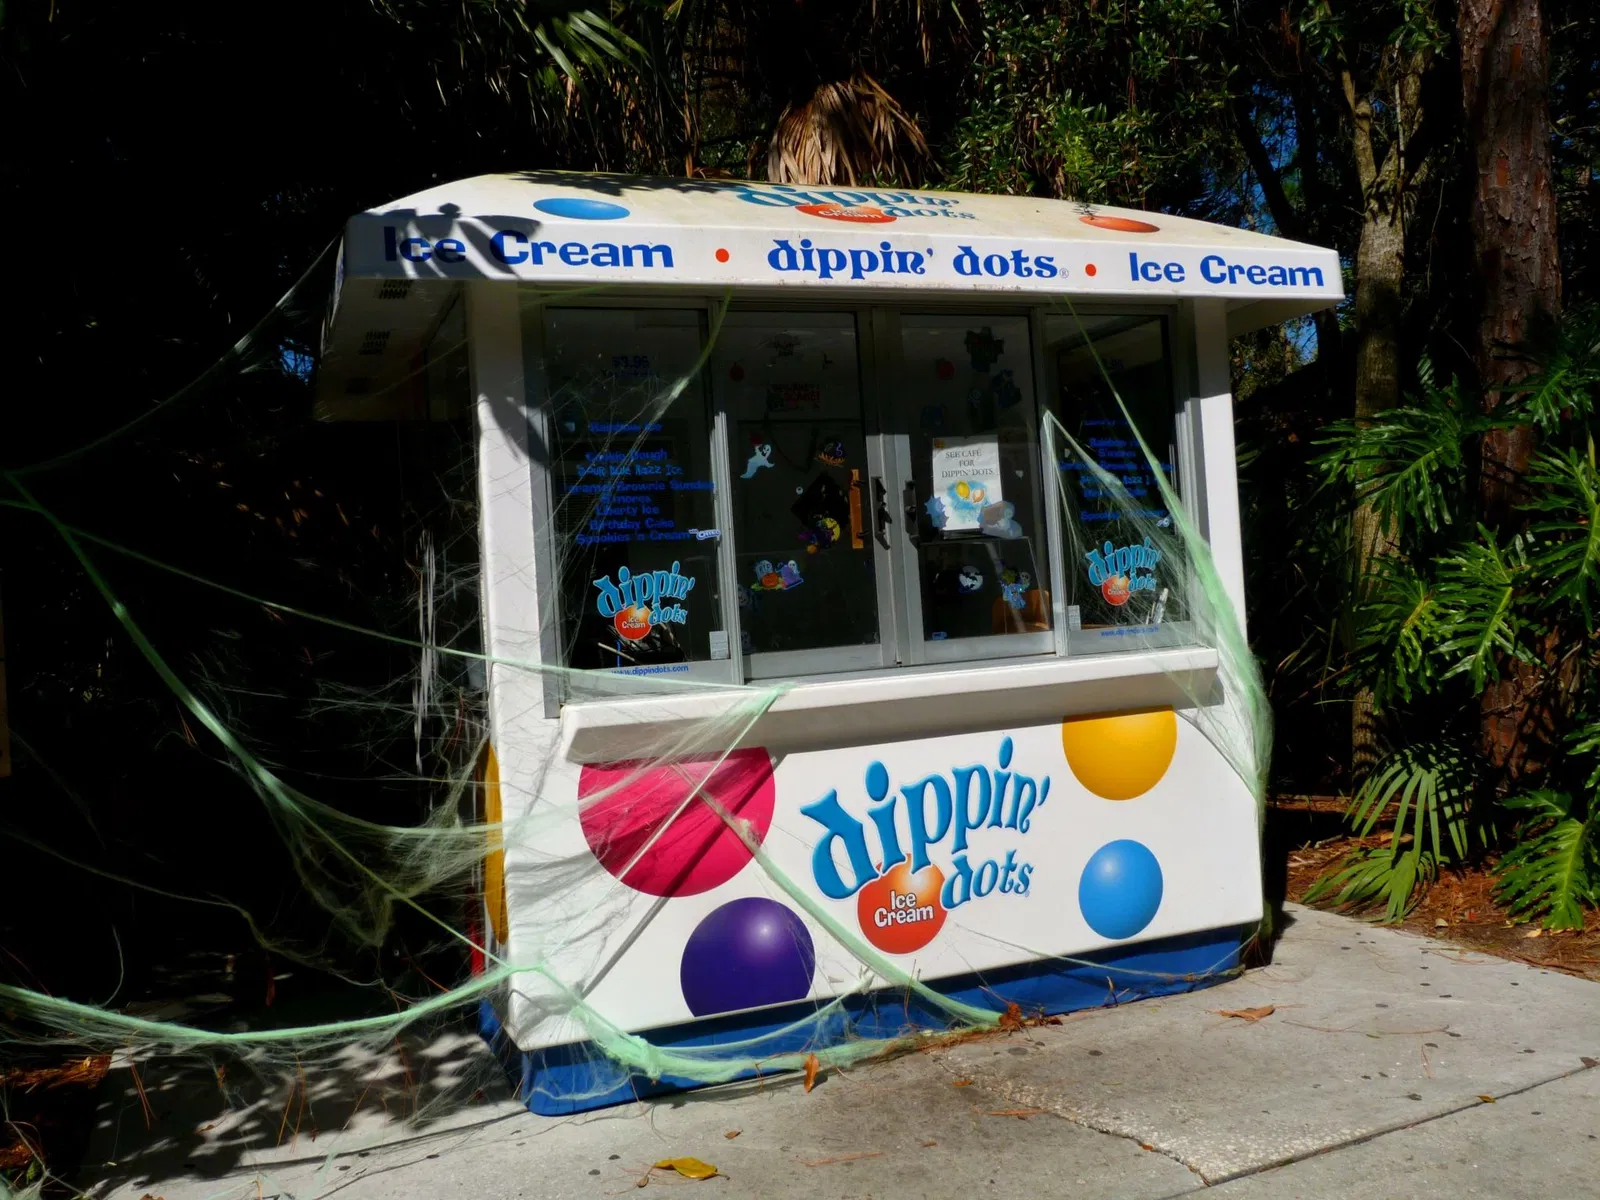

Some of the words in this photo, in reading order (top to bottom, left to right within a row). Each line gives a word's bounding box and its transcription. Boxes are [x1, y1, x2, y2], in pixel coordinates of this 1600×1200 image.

[882, 206, 979, 220] dots
[384, 226, 466, 263] Ice
[490, 229, 674, 268] Cream
[768, 238, 934, 280] dippin'
[1130, 252, 1186, 283] Ice
[1200, 254, 1325, 287] Cream
[945, 450, 961, 459] SEE
[959, 459, 976, 467] FOR
[941, 469, 971, 478] DIPPIN'
[972, 468, 995, 476] DOTS
[593, 560, 695, 618] dippin'
[648, 602, 688, 626] dots
[800, 735, 1050, 900] dippin'
[940, 849, 1034, 910] dots
[889, 890, 917, 908] Ice
[874, 905, 934, 928] Cream
